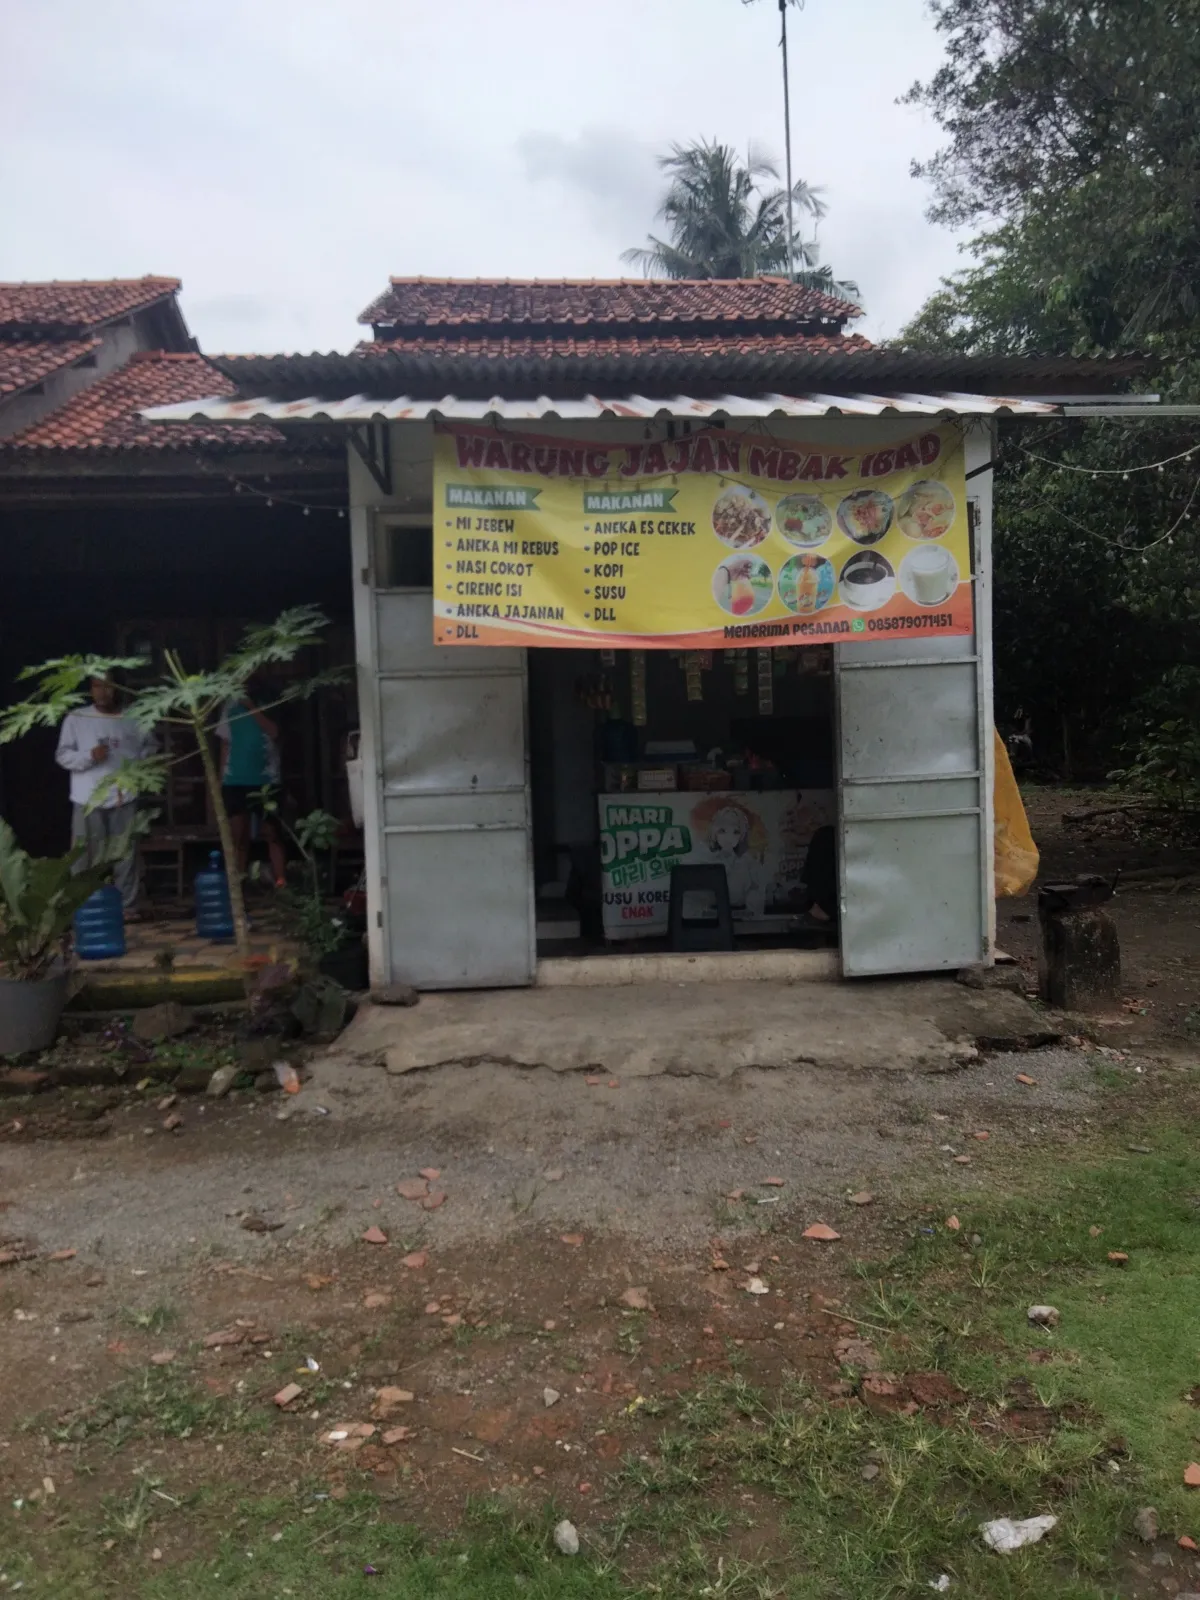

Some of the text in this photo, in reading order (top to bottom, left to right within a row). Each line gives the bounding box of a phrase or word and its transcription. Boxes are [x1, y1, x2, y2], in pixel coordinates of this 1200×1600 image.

[456, 433, 941, 480] WARUNG JAJAN MBAK IBAD
[450, 488, 527, 506] MAKANAN
[587, 493, 664, 510] MAKANAN
[456, 516, 515, 533] MI JEBEW
[593, 520, 696, 535] ANEKA ES CEKEK
[456, 538, 559, 555] ANEKA MI REBUS
[594, 542, 640, 556] POP ICE
[456, 560, 534, 576] NASI COKOT
[594, 564, 623, 578] KOPI
[506, 584, 522, 597] ISI
[594, 586, 626, 600] SUSU
[456, 604, 564, 620] ANEKA JAJANAN
[594, 608, 616, 621] DLL
[456, 625, 479, 639] DLL
[608, 808, 666, 826] MARI
[600, 827, 685, 866] OPPA
[779, 860, 806, 874] OPP
[602, 891, 672, 906] USU KORE
[621, 905, 654, 920] ENAK
